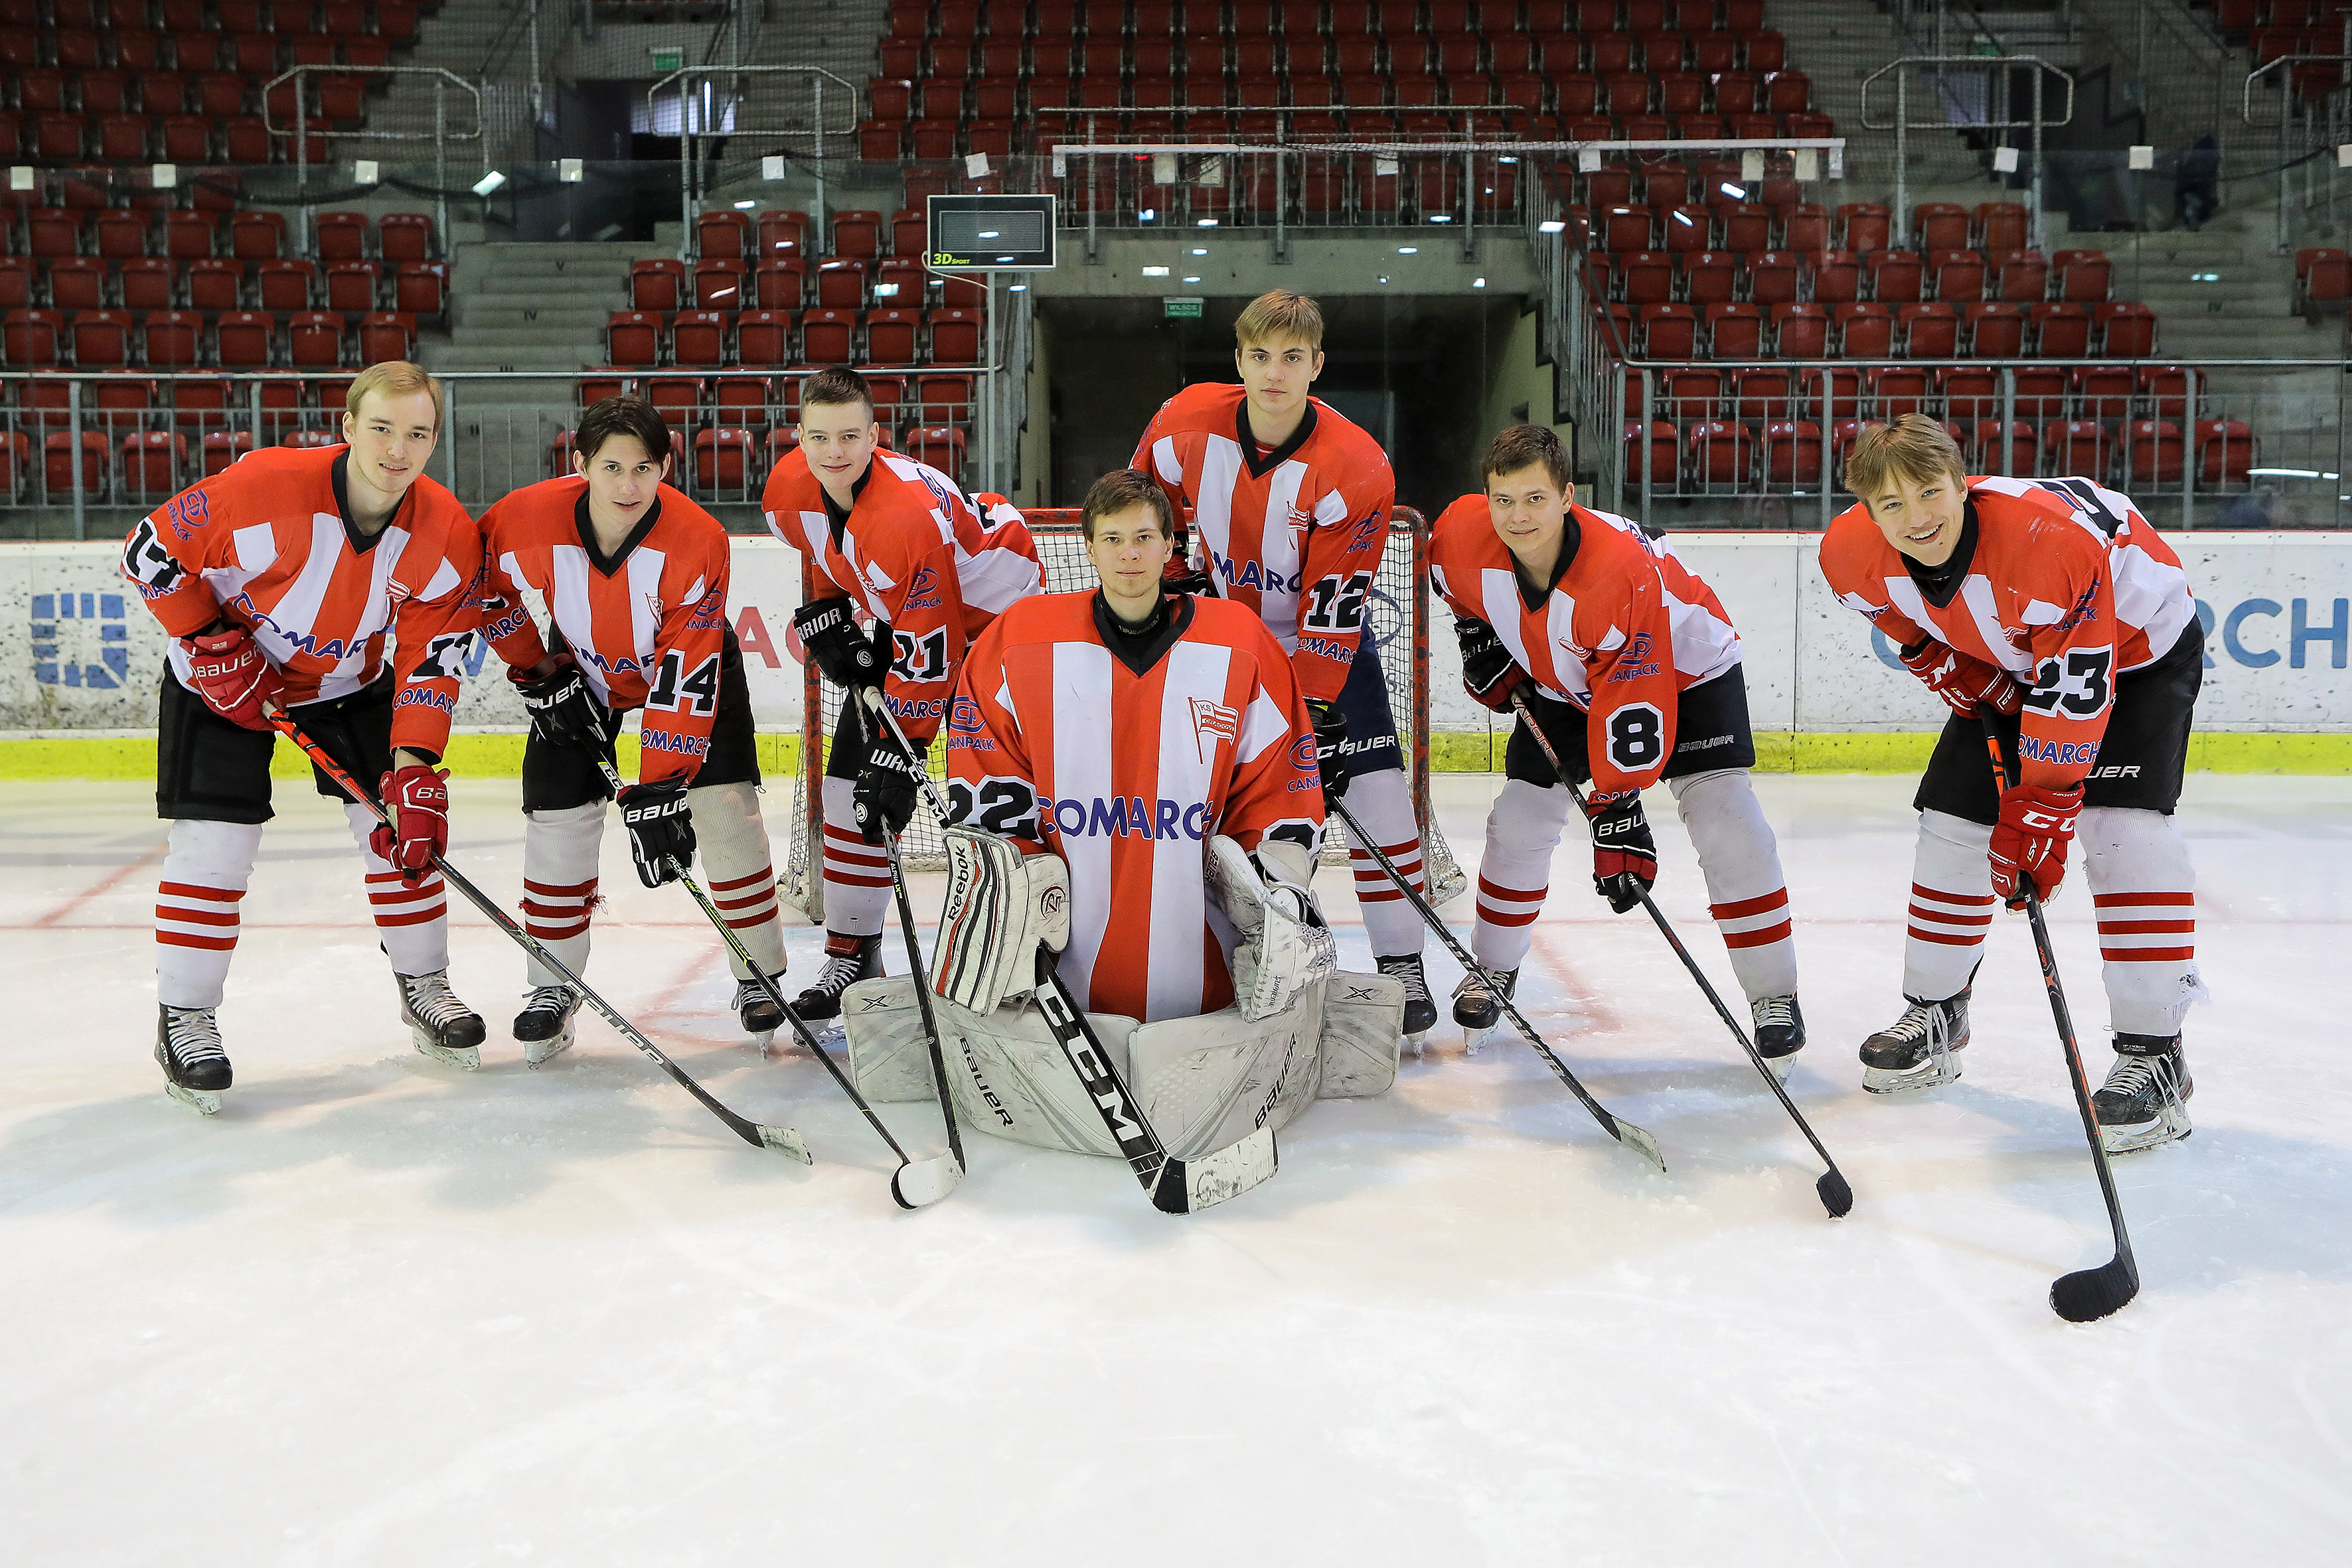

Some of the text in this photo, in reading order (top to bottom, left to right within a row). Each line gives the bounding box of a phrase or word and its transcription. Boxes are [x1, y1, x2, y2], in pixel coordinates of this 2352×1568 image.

[933, 253, 952, 264] 3D
[796, 607, 842, 642] RRIOR
[1302, 570, 1373, 633] 12
[642, 648, 721, 717] 14
[2023, 642, 2113, 721] 23
[948, 735, 997, 751] ANPACK
[1605, 701, 1665, 773] 8
[1678, 734, 1734, 752] BAUER
[947, 844, 966, 921] Reebok
[960, 1037, 1014, 1127] BAUER
[1036, 974, 1144, 1142] CCM
[1254, 1032, 1296, 1131] BAUER
